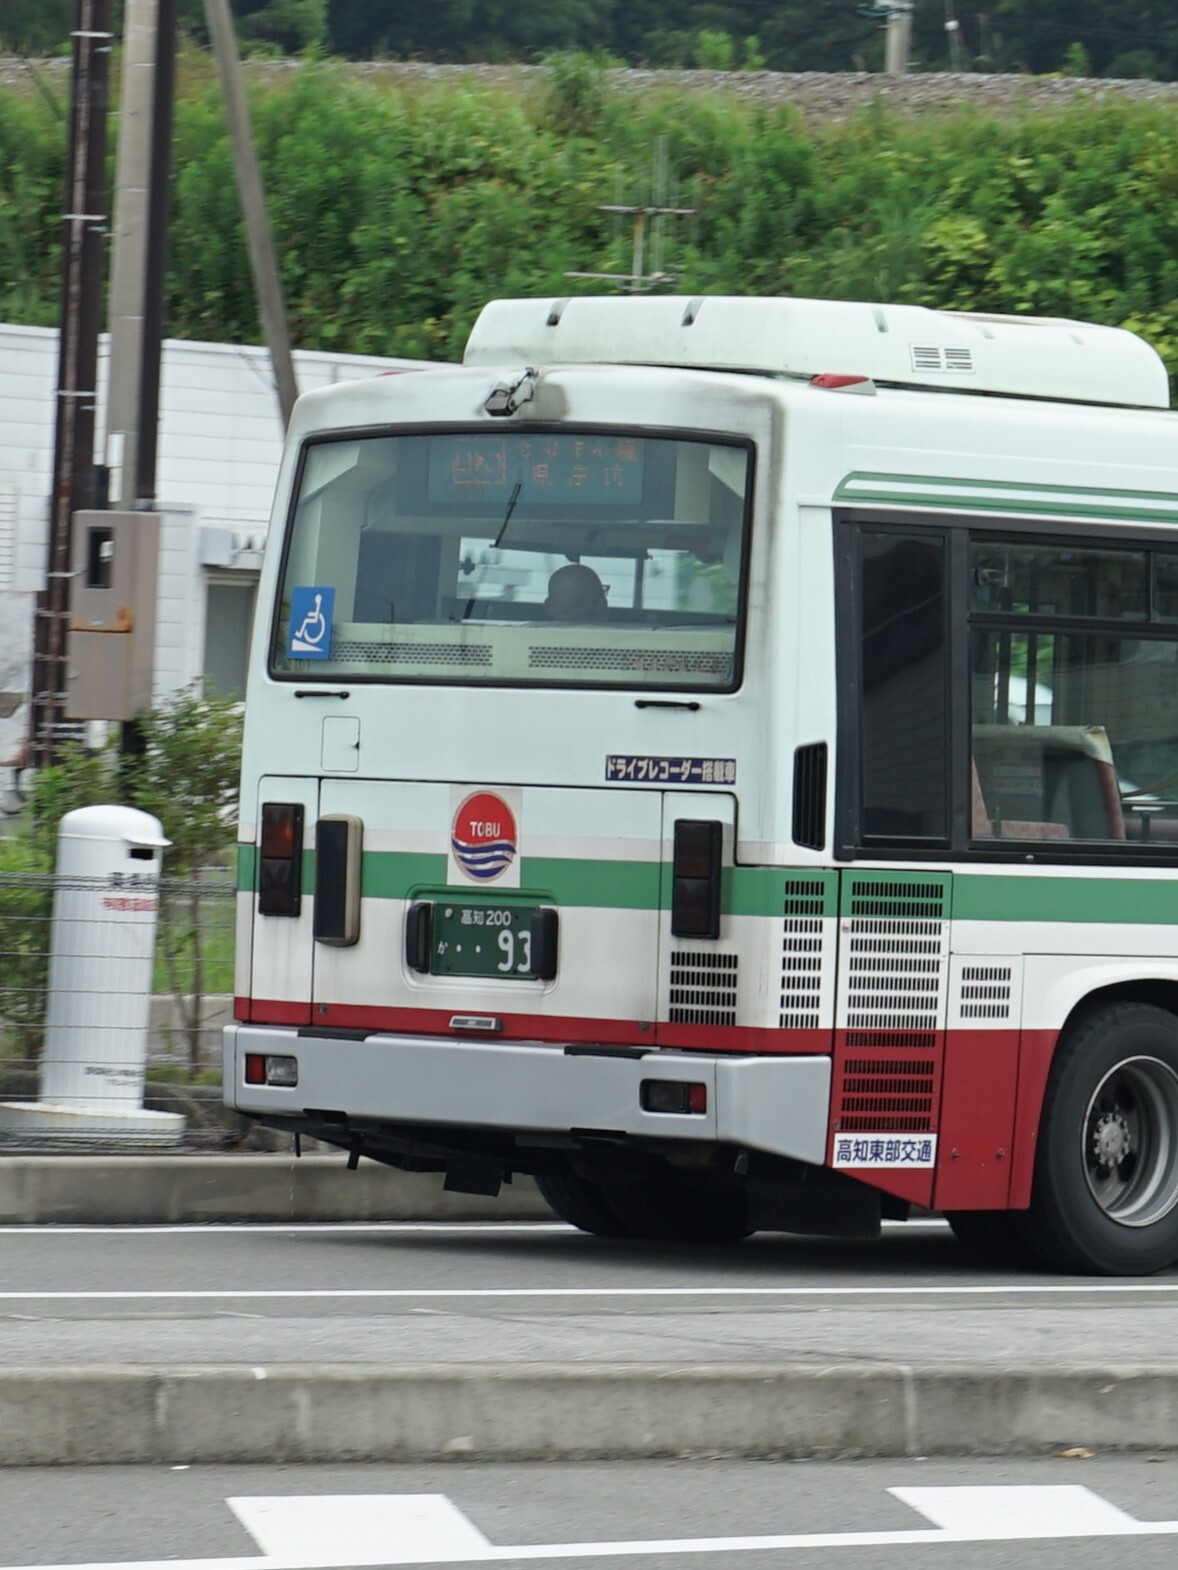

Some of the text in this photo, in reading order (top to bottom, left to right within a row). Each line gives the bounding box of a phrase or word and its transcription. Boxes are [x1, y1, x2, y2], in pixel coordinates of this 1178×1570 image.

[469, 821, 501, 838] TOBU
[461, 909, 511, 926] 高知 200
[836, 1139, 932, 1163] 高知東部交通
